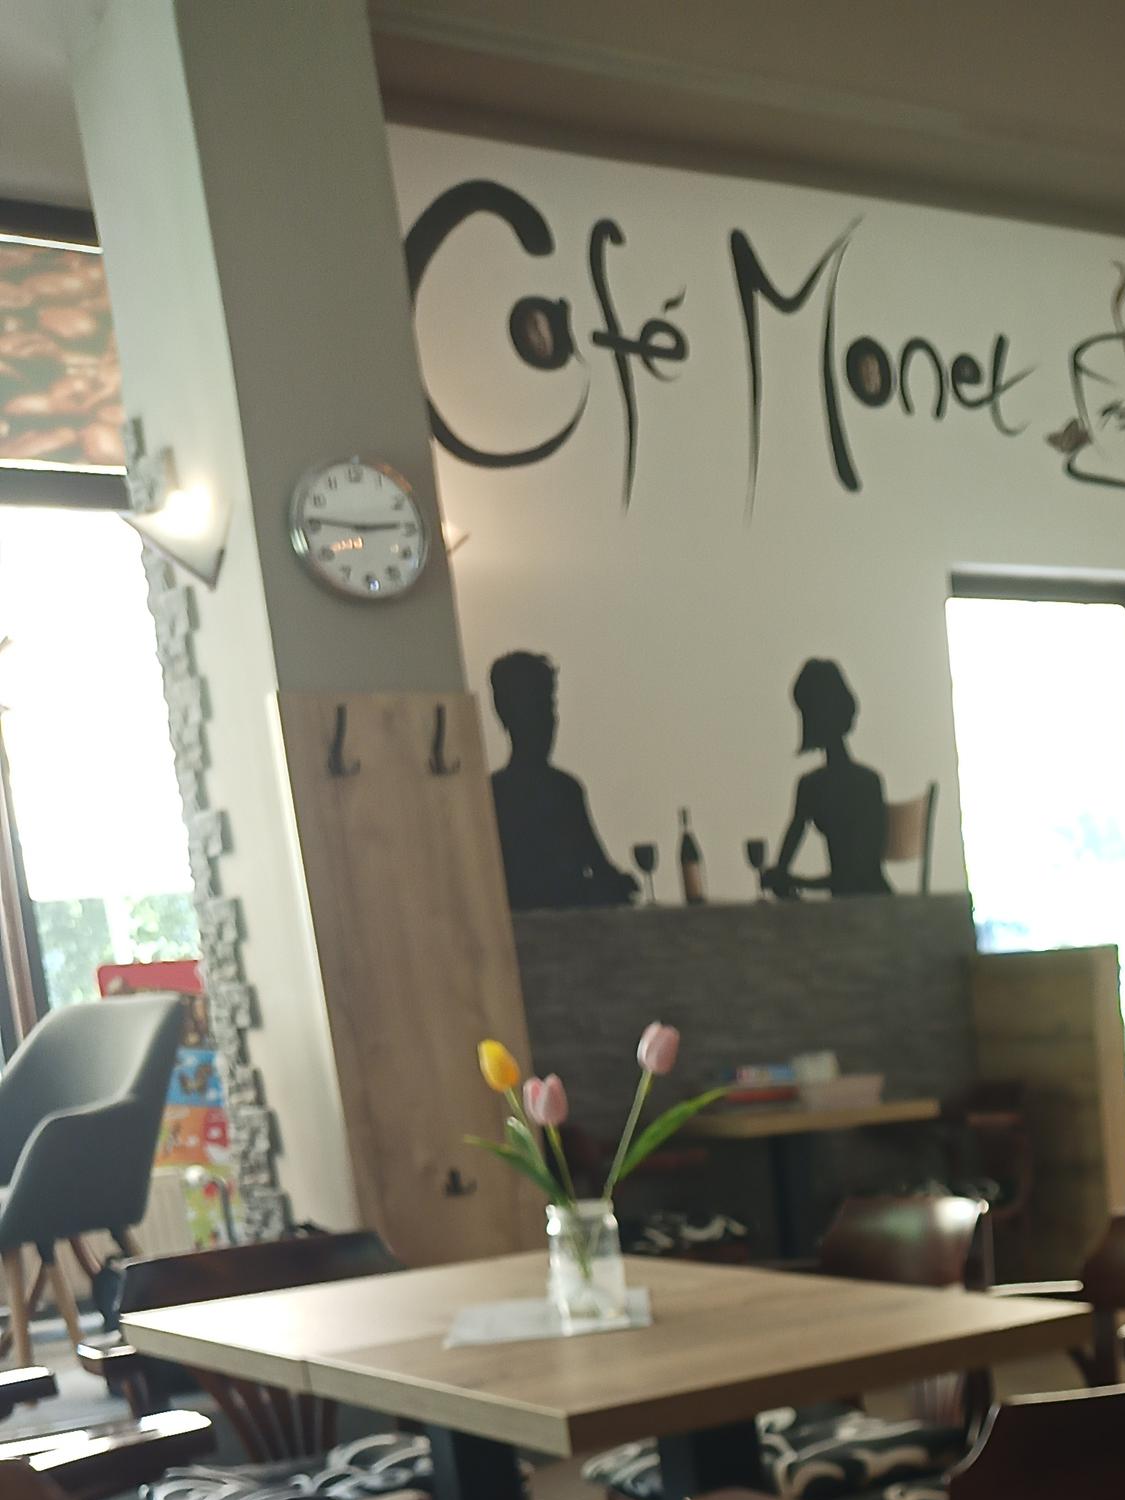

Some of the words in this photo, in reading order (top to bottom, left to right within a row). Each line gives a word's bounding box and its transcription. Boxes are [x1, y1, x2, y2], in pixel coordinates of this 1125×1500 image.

[404, 180, 690, 515] Café
[728, 214, 1034, 525] Monet
[327, 475, 338, 490] 11
